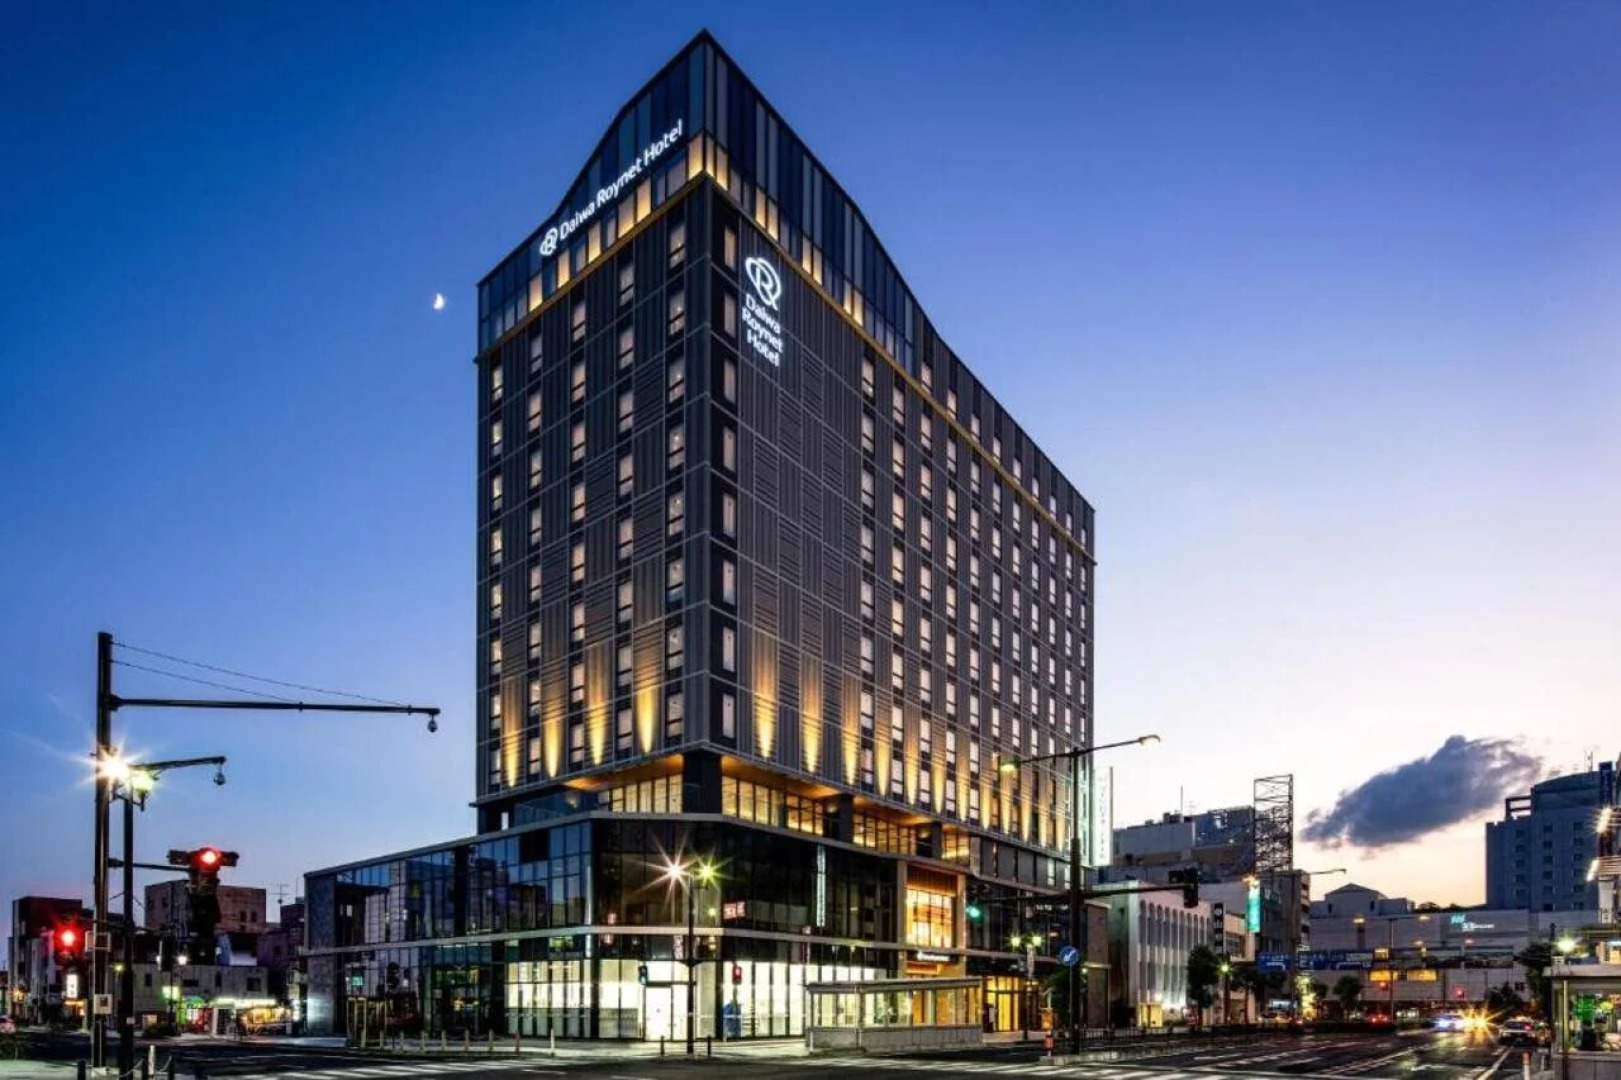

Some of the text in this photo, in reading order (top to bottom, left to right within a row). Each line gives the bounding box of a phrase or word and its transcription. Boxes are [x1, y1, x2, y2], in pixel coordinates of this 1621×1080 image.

[560, 202, 595, 240] Daiwa
[596, 157, 643, 208] Roynet
[643, 118, 683, 167] Hotel
[742, 306, 783, 353] Roynet
[746, 293, 781, 334] Daiwa
[746, 328, 780, 367] Hotel
